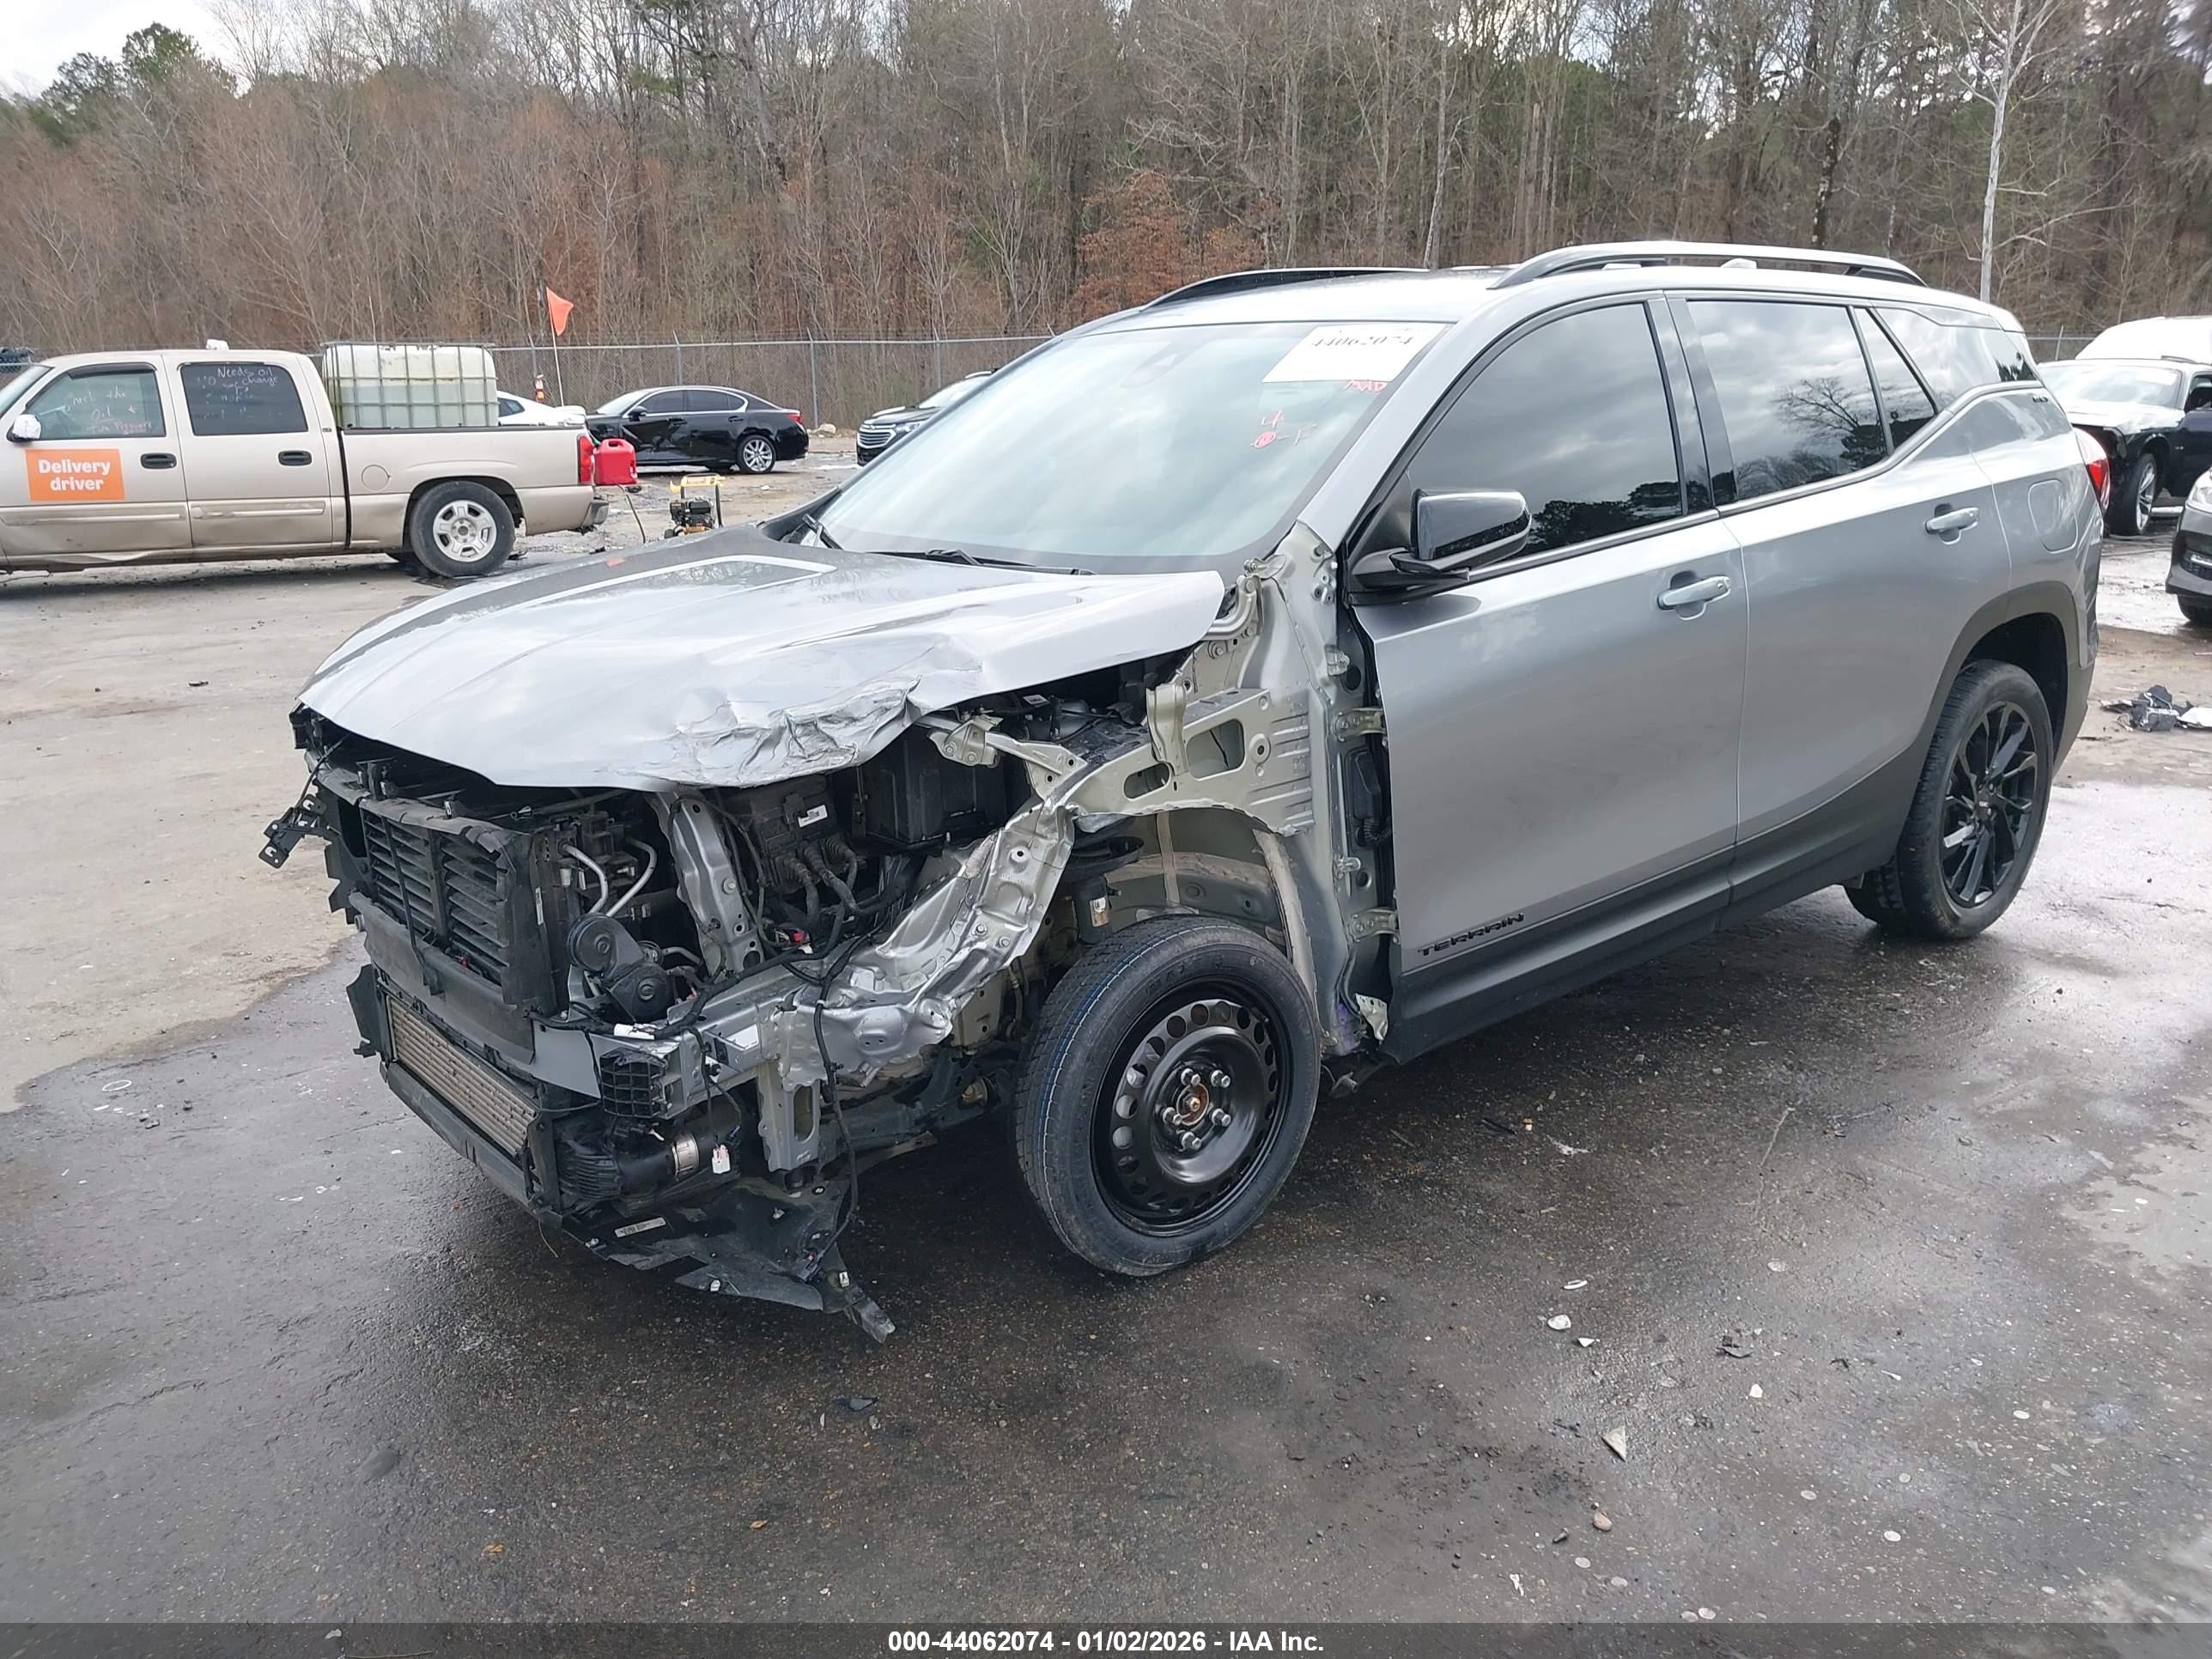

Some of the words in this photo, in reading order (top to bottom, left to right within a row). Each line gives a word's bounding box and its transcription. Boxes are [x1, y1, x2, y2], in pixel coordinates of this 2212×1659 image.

[217, 366, 255, 380] Needs
[38, 459, 111, 476] Delivery
[50, 476, 104, 491] driver
[1419, 912, 1525, 957] TERRAIN
